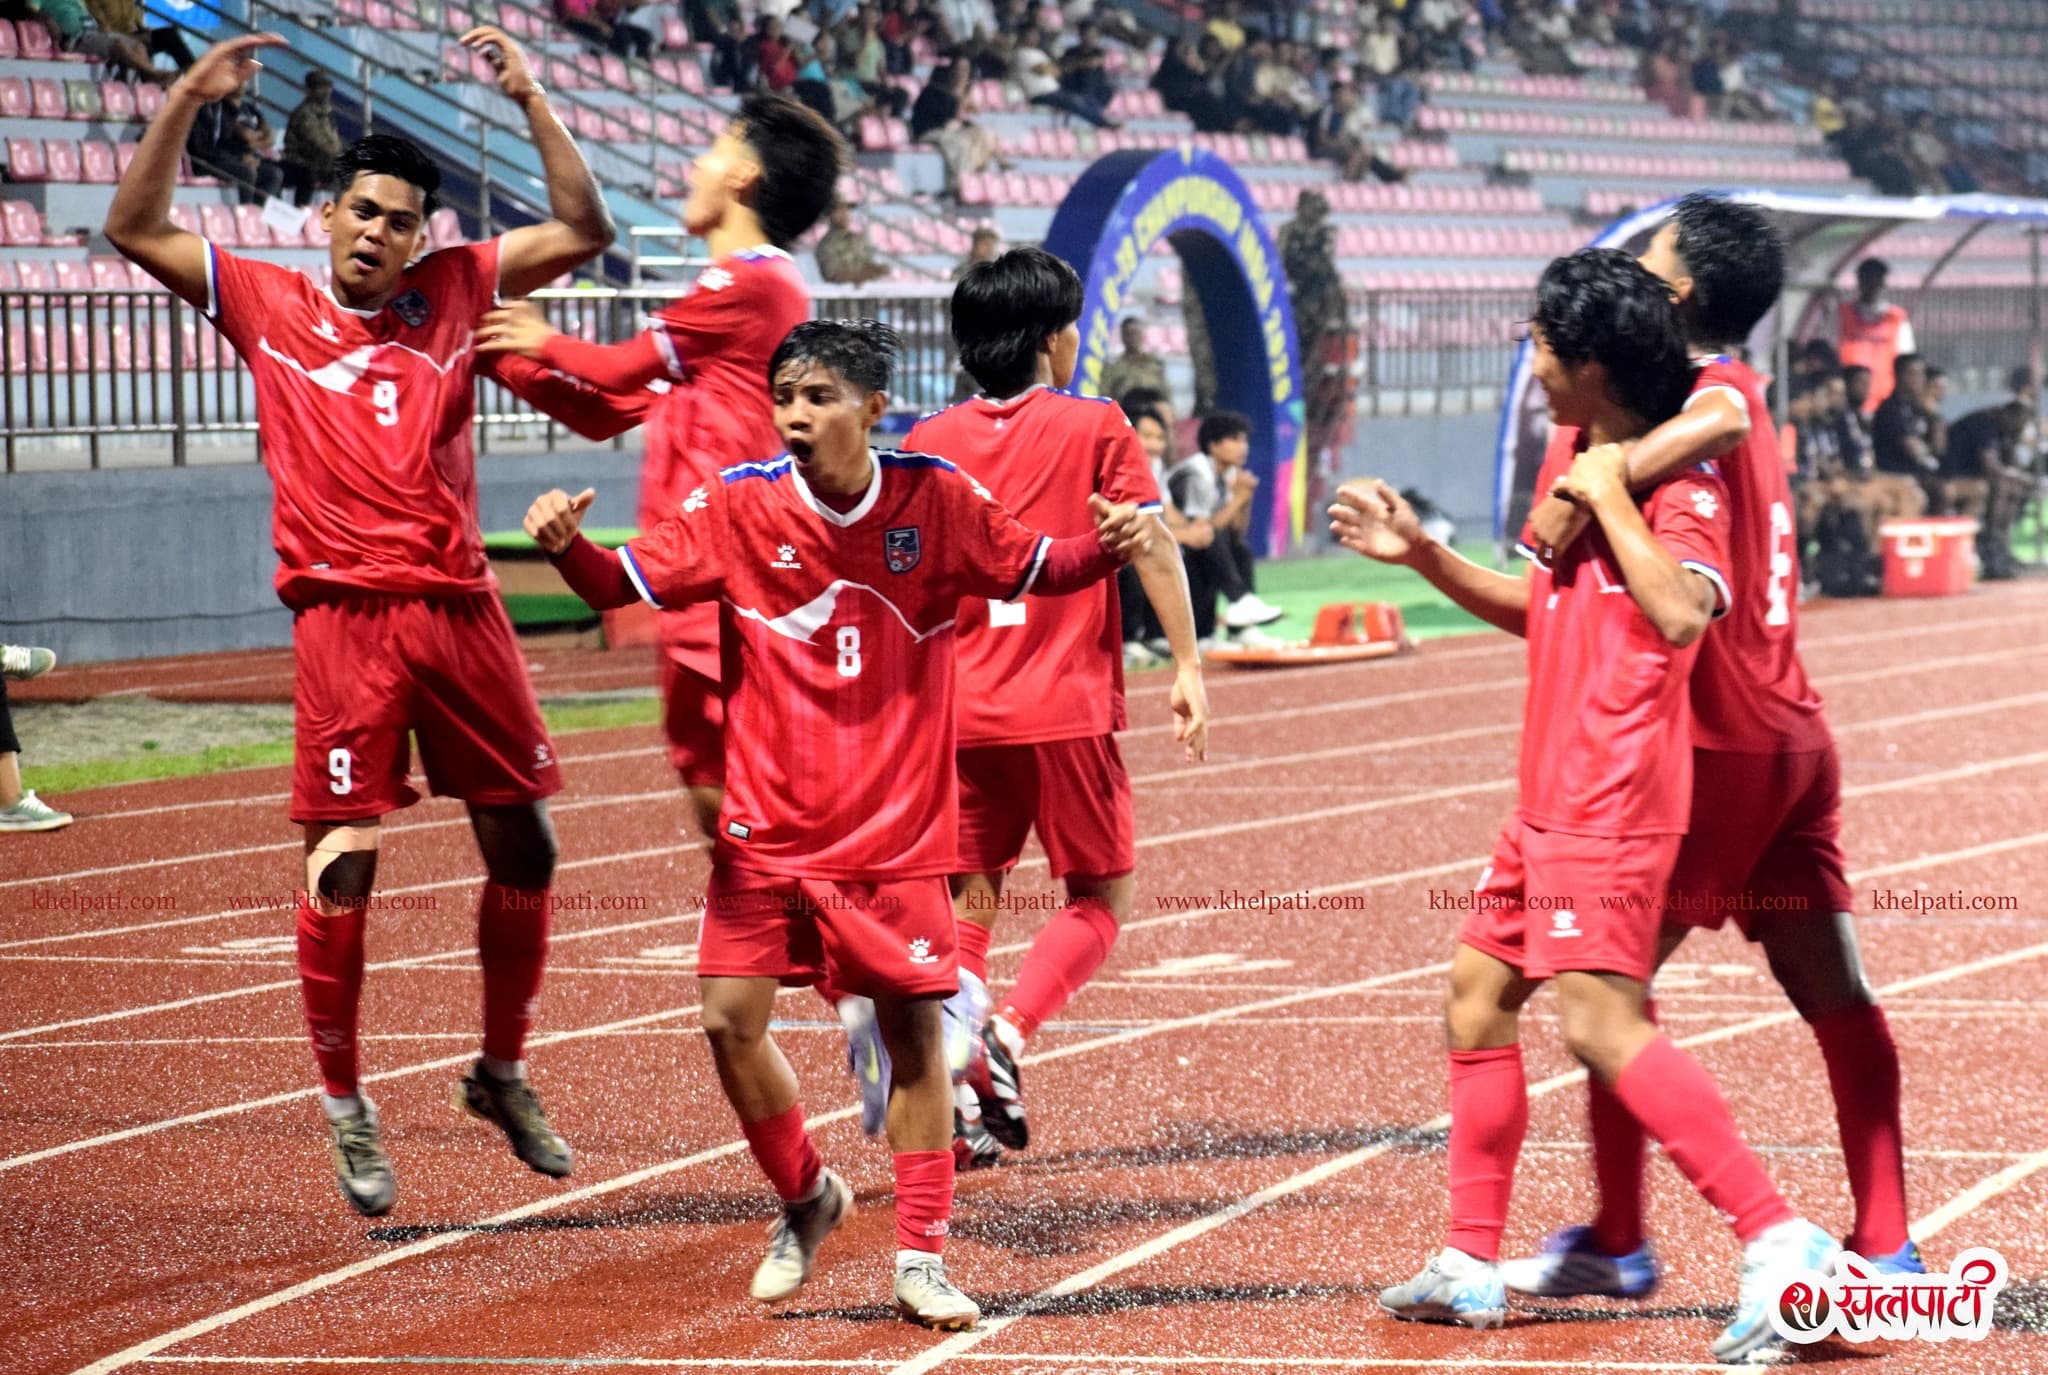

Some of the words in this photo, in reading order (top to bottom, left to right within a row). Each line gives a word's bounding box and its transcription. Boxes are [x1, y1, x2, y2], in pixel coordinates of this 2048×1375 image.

[373, 380, 399, 426] 9
[837, 625, 862, 677] 8
[329, 748, 352, 794] 9
